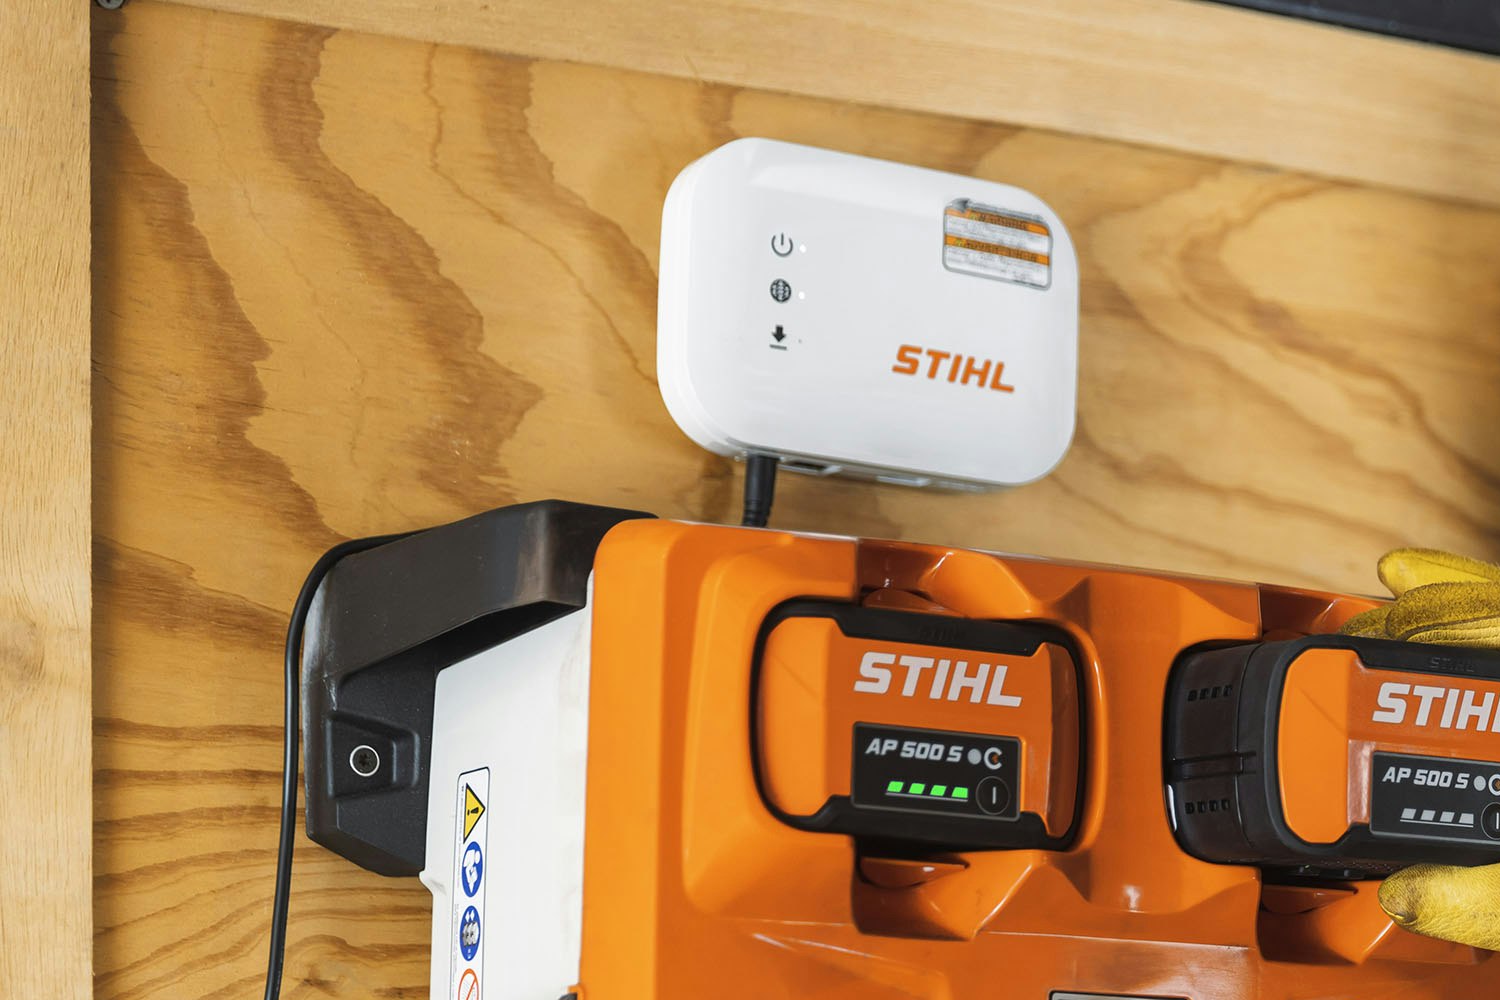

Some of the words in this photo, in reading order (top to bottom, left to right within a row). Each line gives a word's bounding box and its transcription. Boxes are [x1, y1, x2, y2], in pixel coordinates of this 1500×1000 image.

[892, 345, 1015, 394] STIHL
[853, 651, 1022, 707] STIHL
[865, 737, 899, 756] AP
[900, 741, 945, 761] 500
[946, 745, 963, 763] S
[1382, 765, 1411, 784] AP
[1413, 769, 1453, 788] 500
[1455, 772, 1470, 790] S
